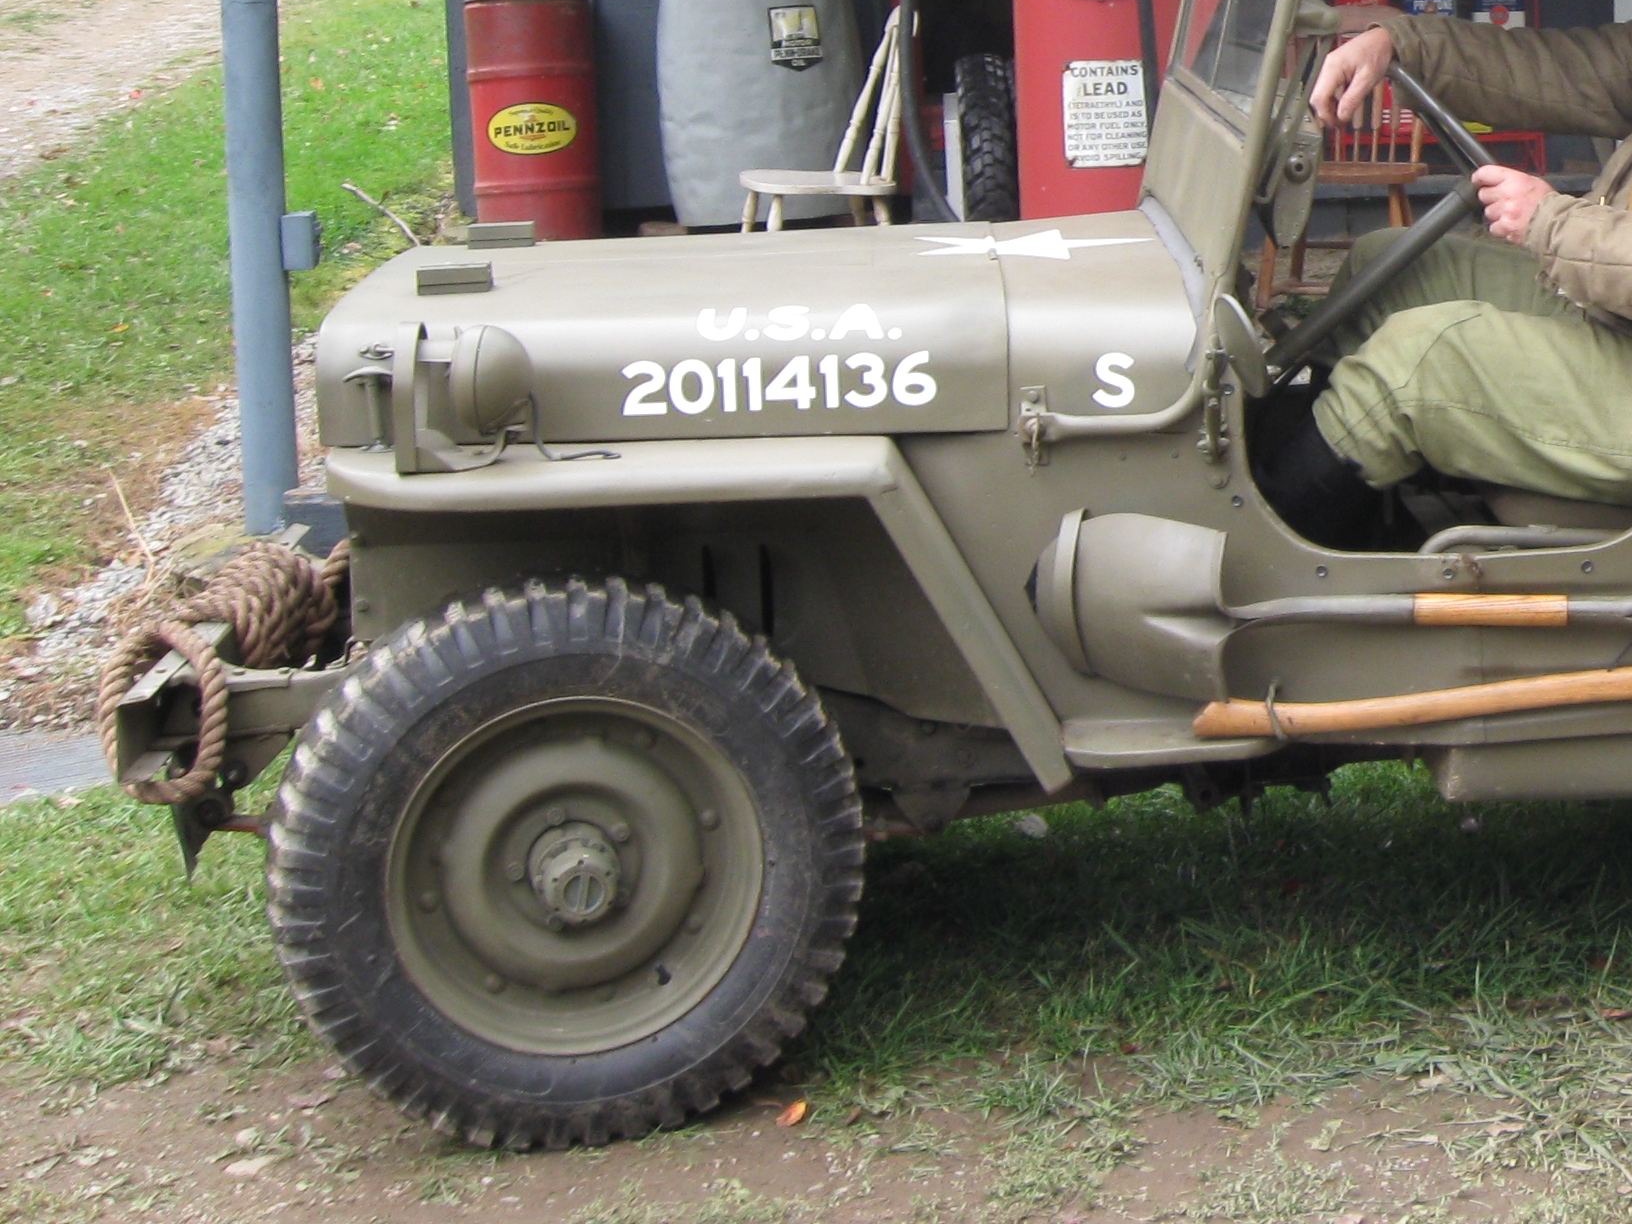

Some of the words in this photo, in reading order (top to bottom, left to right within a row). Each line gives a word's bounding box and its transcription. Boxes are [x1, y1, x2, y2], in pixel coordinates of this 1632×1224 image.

[1071, 64, 1139, 78] CONTAINS
[1082, 81, 1128, 97] LEAD
[1125, 99, 1144, 108] AND
[1130, 110, 1142, 118] AS
[493, 120, 571, 139] PENNZOIL
[695, 303, 903, 342] U.S.A.
[619, 350, 937, 416] 20114136
[1092, 352, 1135, 408] S
